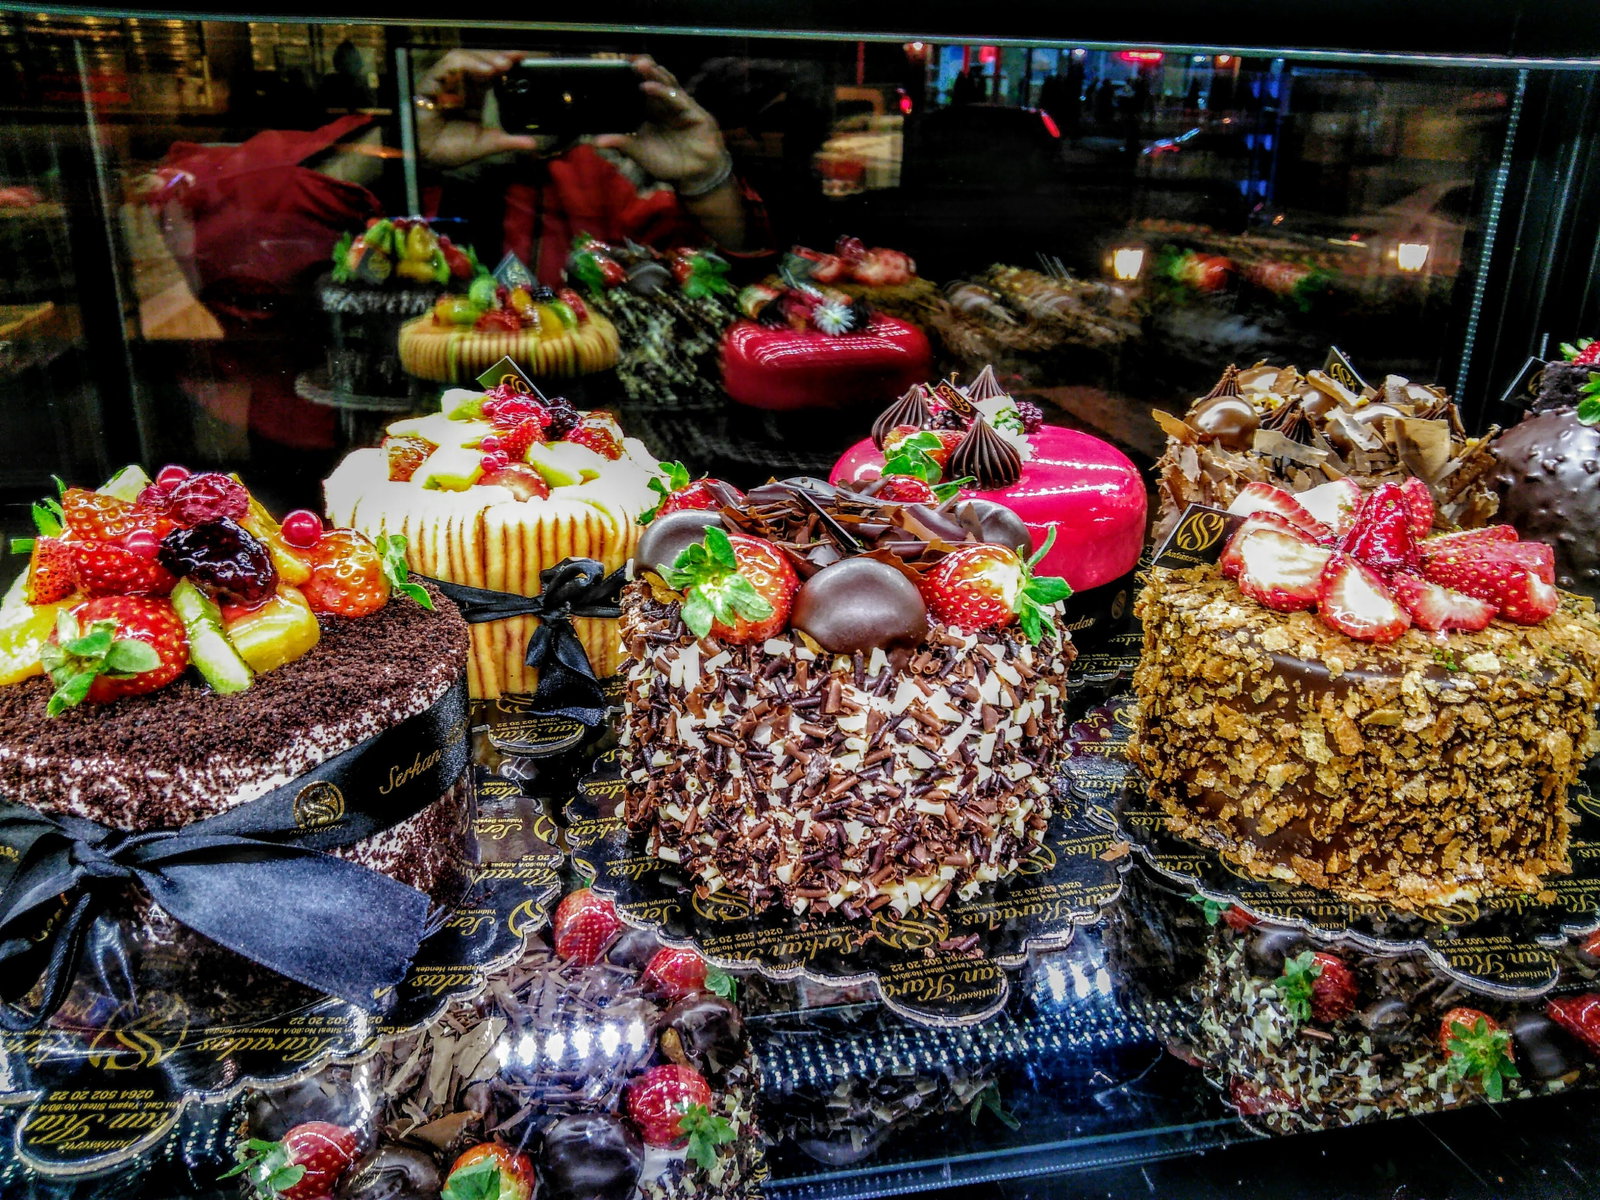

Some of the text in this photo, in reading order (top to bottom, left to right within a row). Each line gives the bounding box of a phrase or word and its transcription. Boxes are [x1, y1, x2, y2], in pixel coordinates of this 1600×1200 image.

[719, 935, 732, 944] 20
[734, 932, 755, 941] 502
[702, 937, 717, 947] 22
[767, 932, 852, 960] Serkan
[889, 963, 905, 972] 22
[906, 961, 922, 970] 20
[1499, 966, 1552, 981] patisserie
[947, 983, 1001, 1004] patisserie
[289, 1016, 305, 1025] 22
[308, 1016, 325, 1025] 20
[197, 1036, 343, 1062] Karadas
[49, 1089, 154, 1101] 0264 502 20 22
[57, 1135, 141, 1154] patisserie
